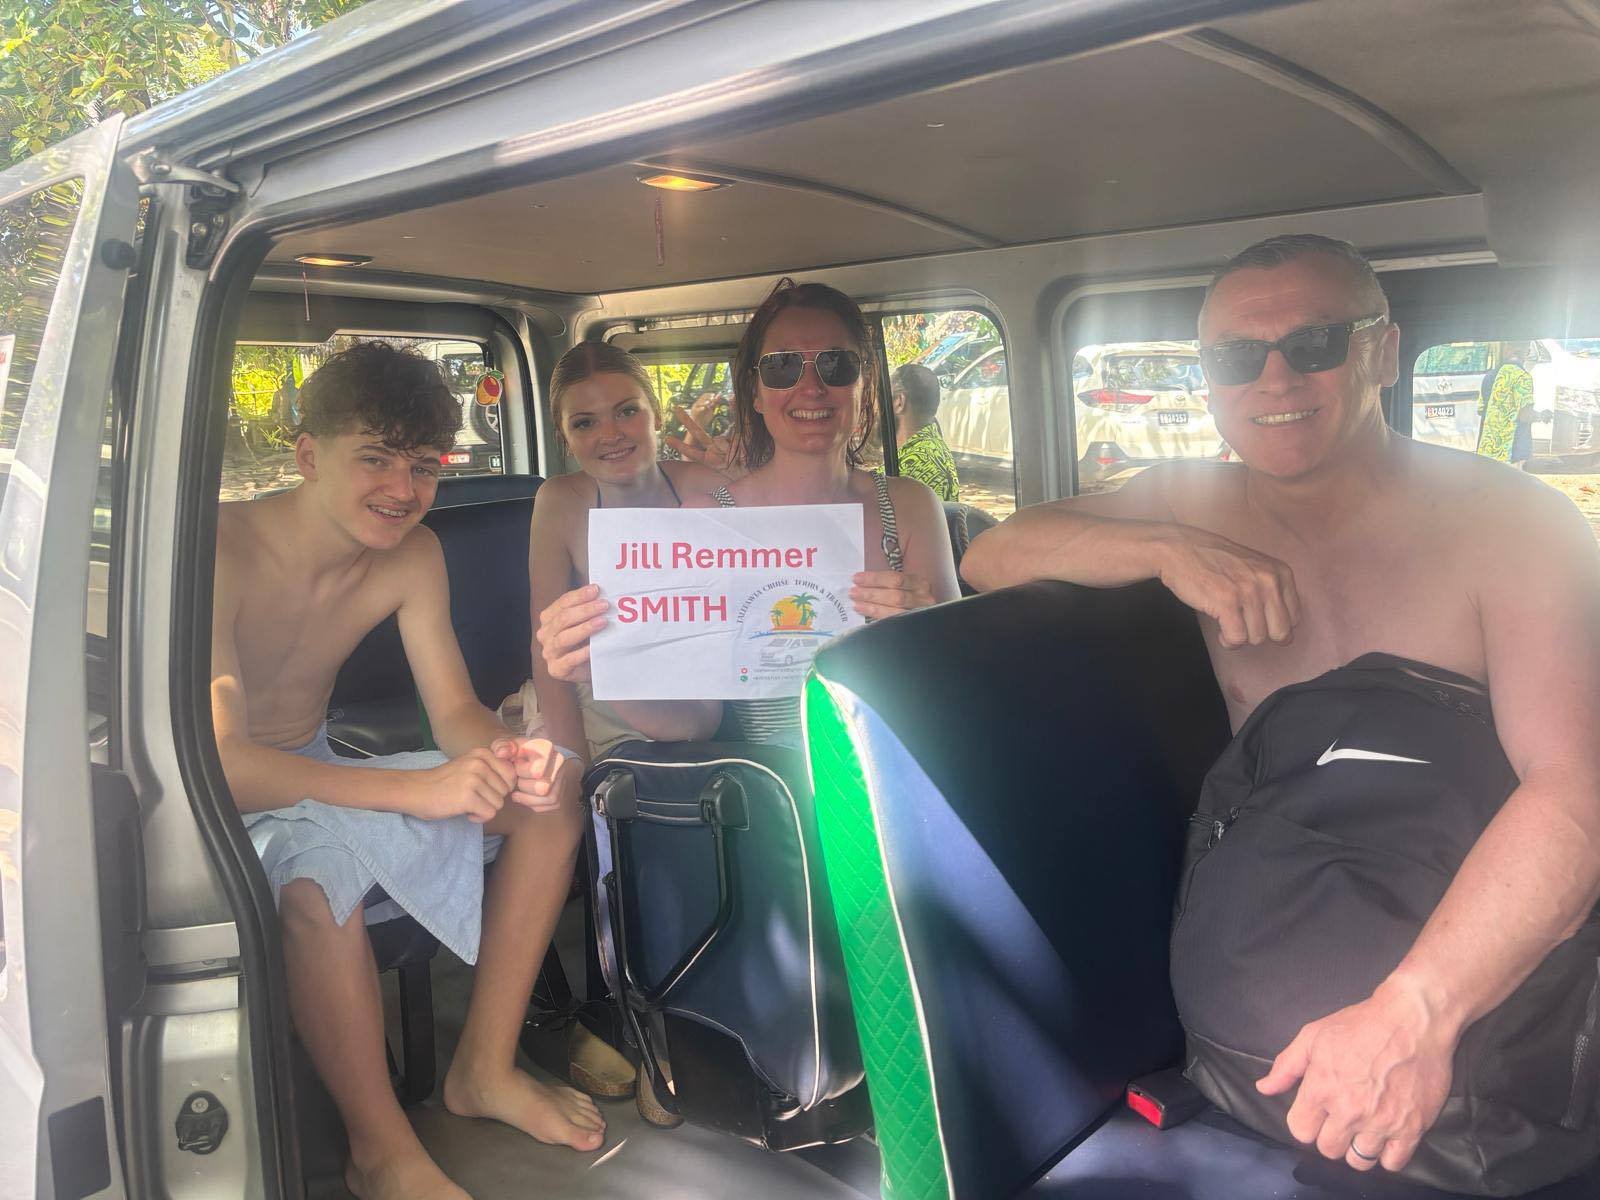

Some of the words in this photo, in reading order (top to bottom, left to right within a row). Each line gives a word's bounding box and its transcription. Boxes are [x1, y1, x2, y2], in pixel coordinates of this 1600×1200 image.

[615, 542, 662, 570] Jill
[672, 542, 818, 569] Remmer
[795, 579, 819, 591] TOURS
[617, 595, 727, 623] SMITH
